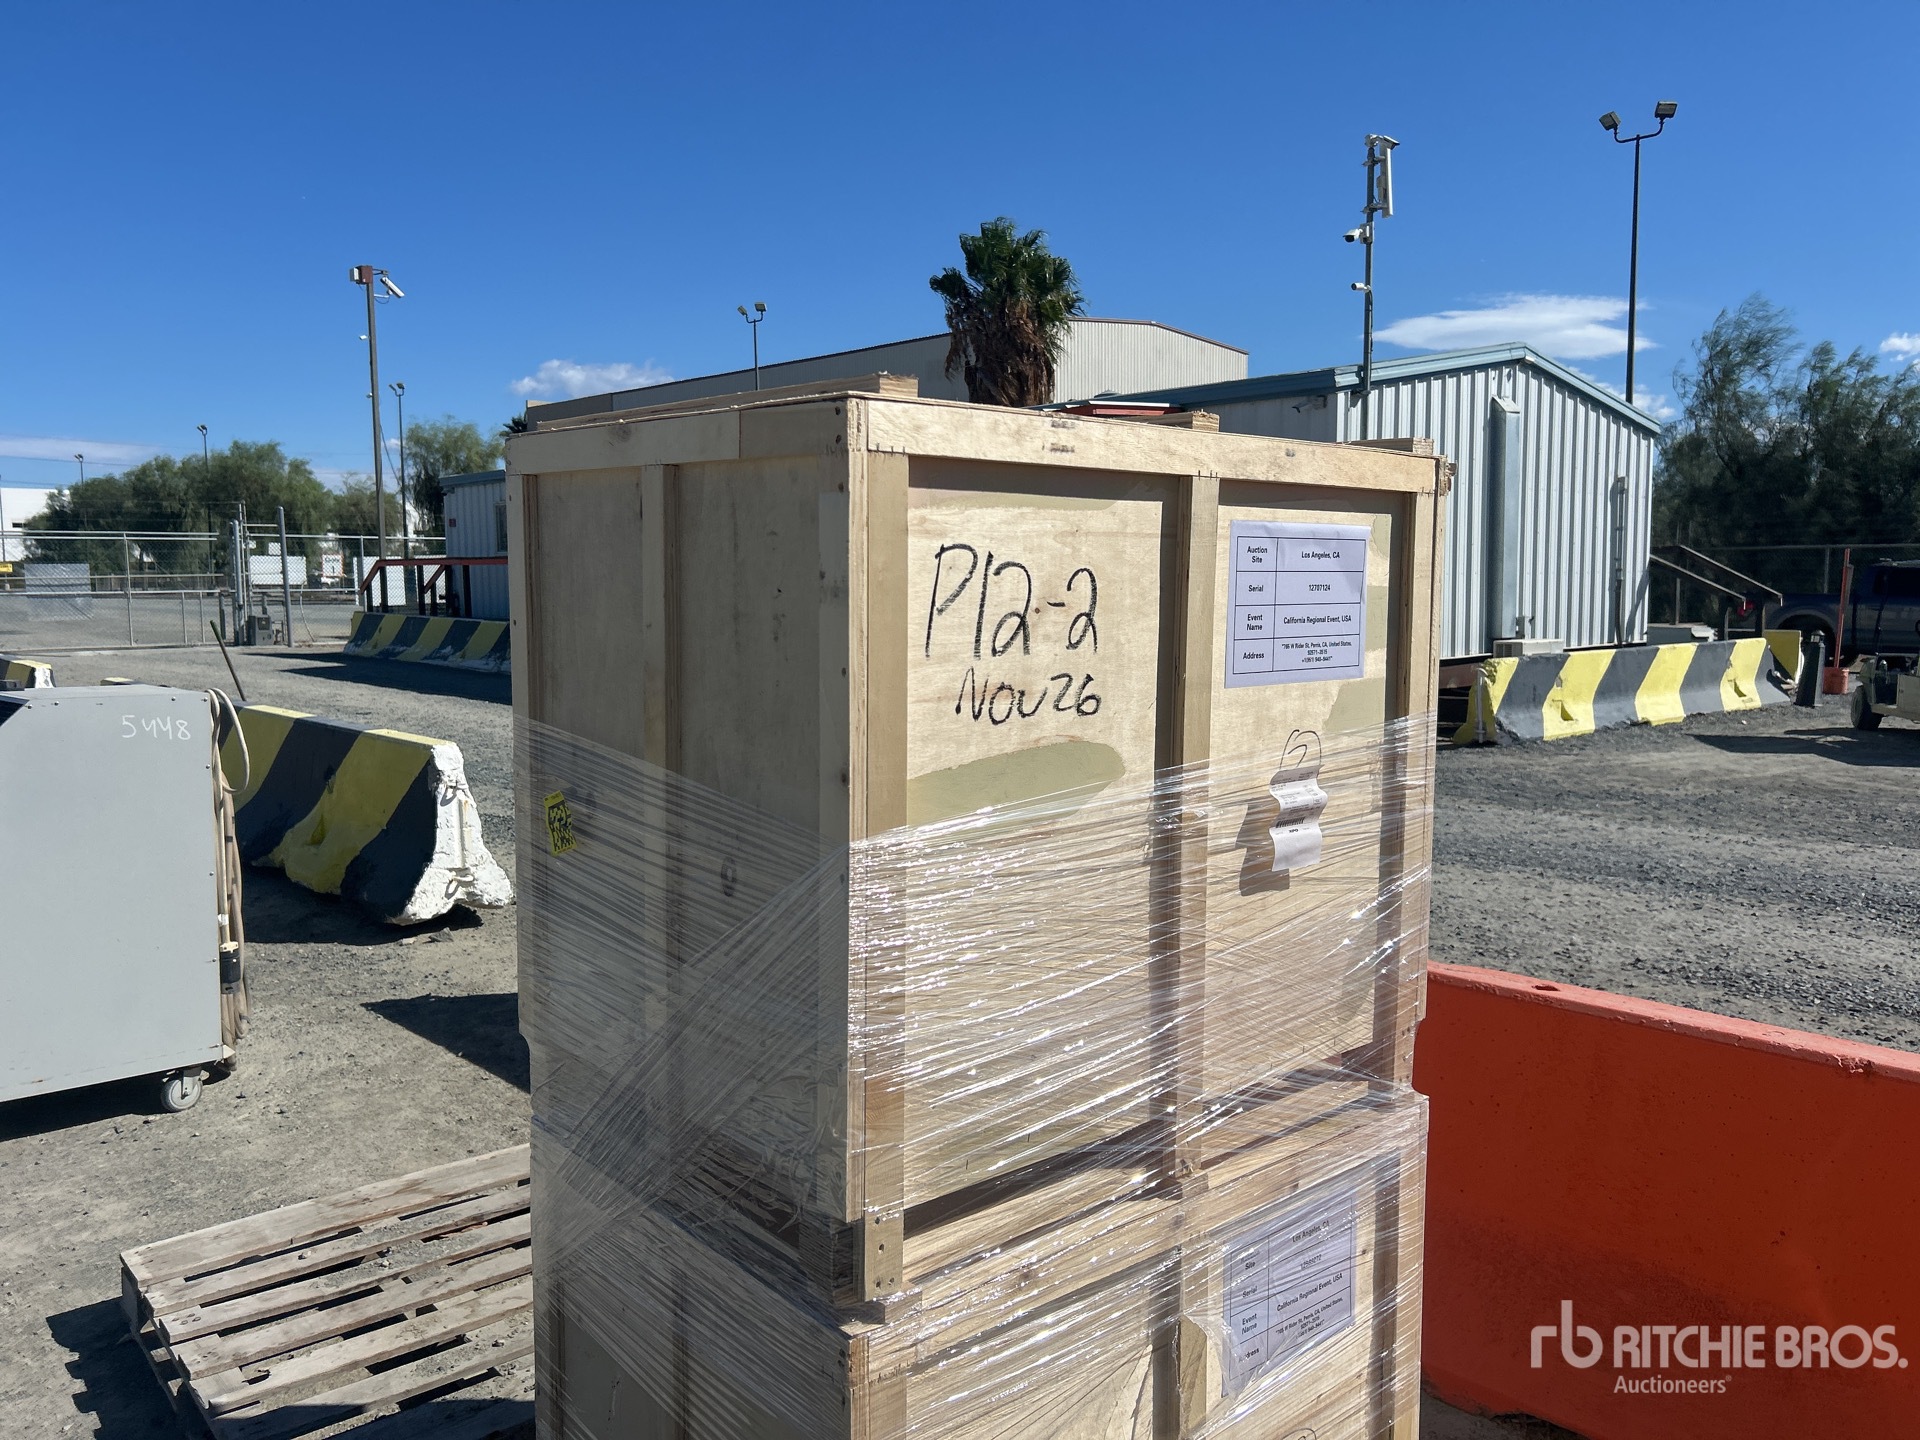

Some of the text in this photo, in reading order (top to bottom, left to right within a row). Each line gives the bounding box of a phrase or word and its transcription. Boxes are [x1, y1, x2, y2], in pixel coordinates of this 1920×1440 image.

[1247, 546, 1268, 554] Auction
[1301, 551, 1340, 560] Los Angeles, CA
[925, 543, 1098, 661] P12-2
[1283, 616, 1306, 624] California
[1306, 616, 1326, 625] Regional
[1327, 615, 1341, 623] Event,
[1246, 623, 1263, 631] Name
[1242, 652, 1265, 660] Address
[122, 714, 191, 740] 5448
[1245, 1261, 1256, 1270] Site
[1242, 1286, 1258, 1298] Serial
[1276, 1297, 1299, 1312] California
[1299, 1285, 1318, 1299] Regional
[1333, 1273, 1343, 1283] USA
[1242, 1313, 1257, 1325] Event
[1241, 1323, 1257, 1335] Name
